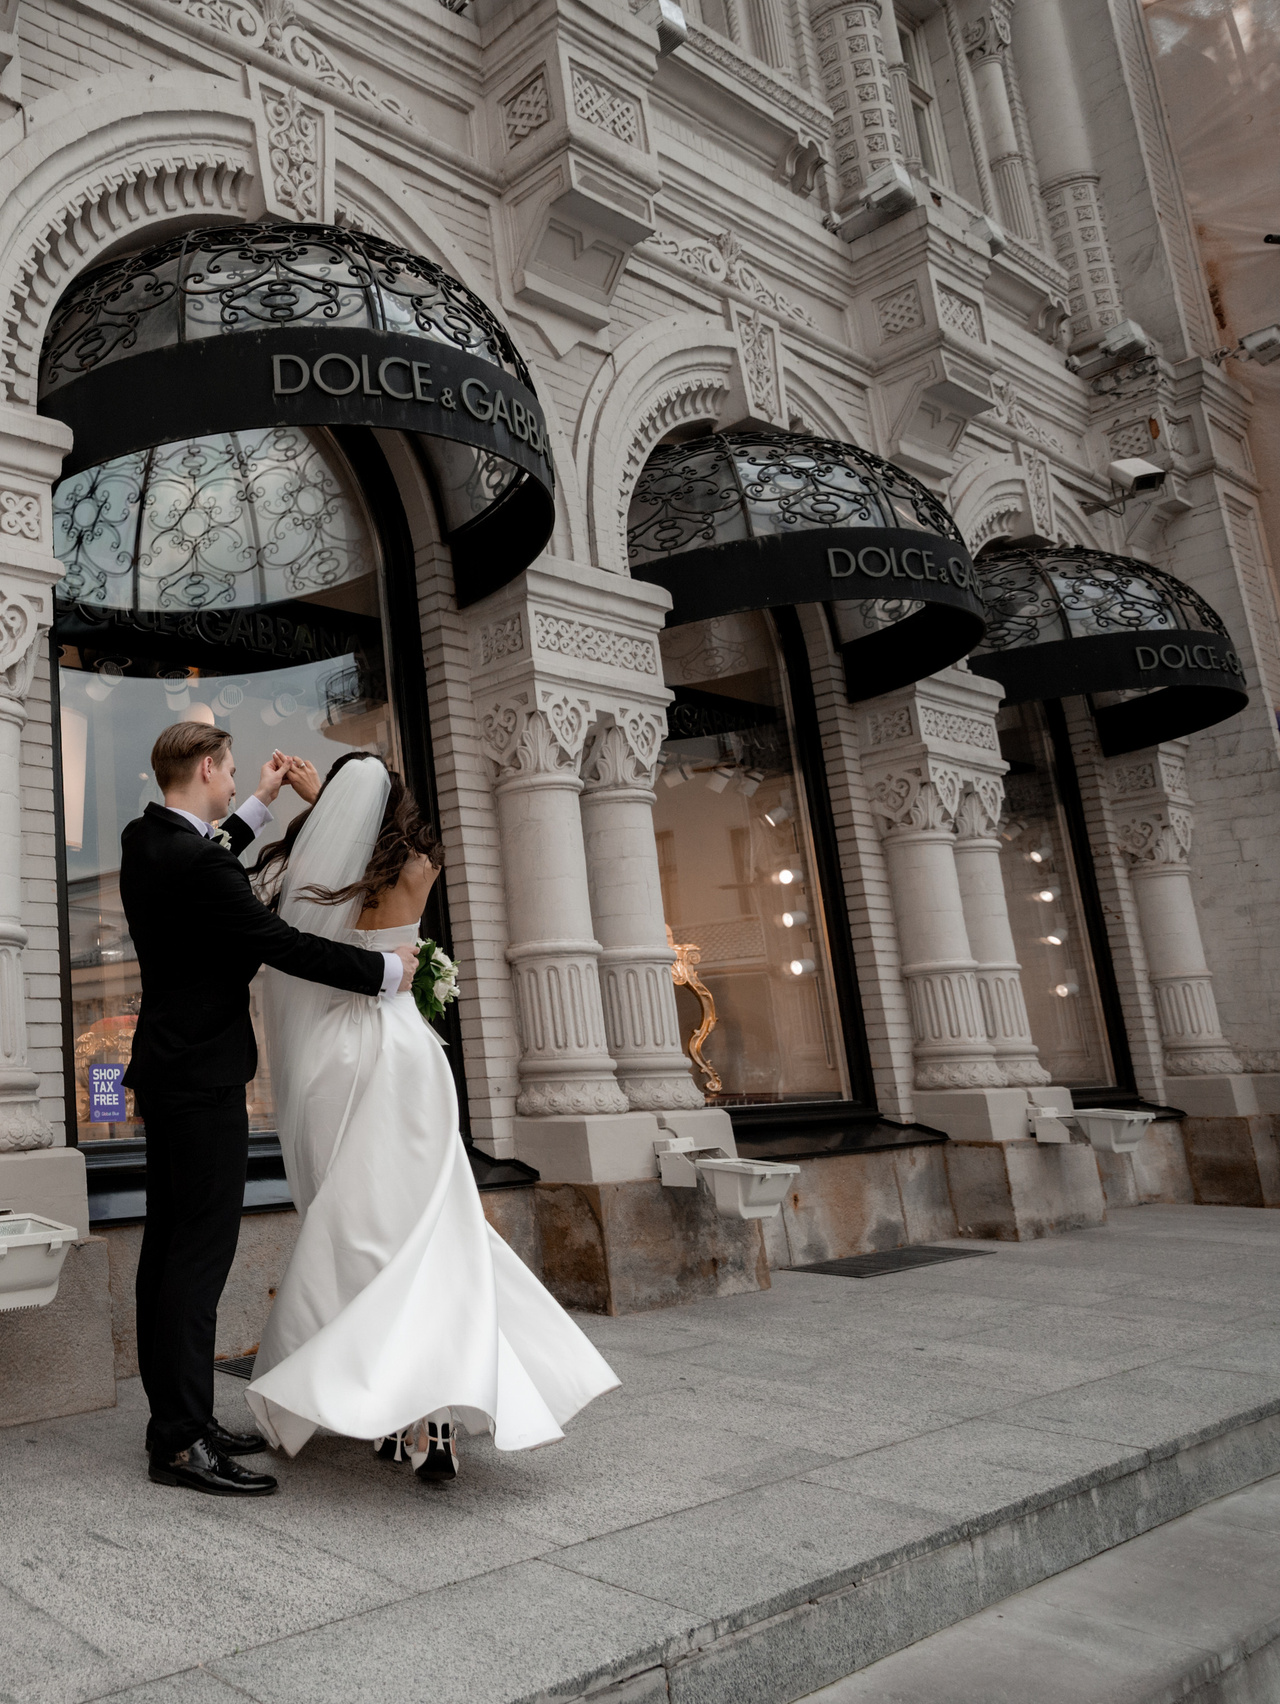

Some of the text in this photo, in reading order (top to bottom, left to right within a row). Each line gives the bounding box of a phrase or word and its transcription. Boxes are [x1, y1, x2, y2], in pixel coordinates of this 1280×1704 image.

[272, 353, 554, 482] DOLCE & GABBA
[827, 546, 938, 581] DOLCE
[939, 567, 950, 584] &
[1135, 644, 1221, 670] DOLCE
[92, 1068, 120, 1080] SHOP
[93, 1081, 114, 1092] TAX
[94, 1093, 119, 1105] FREE
